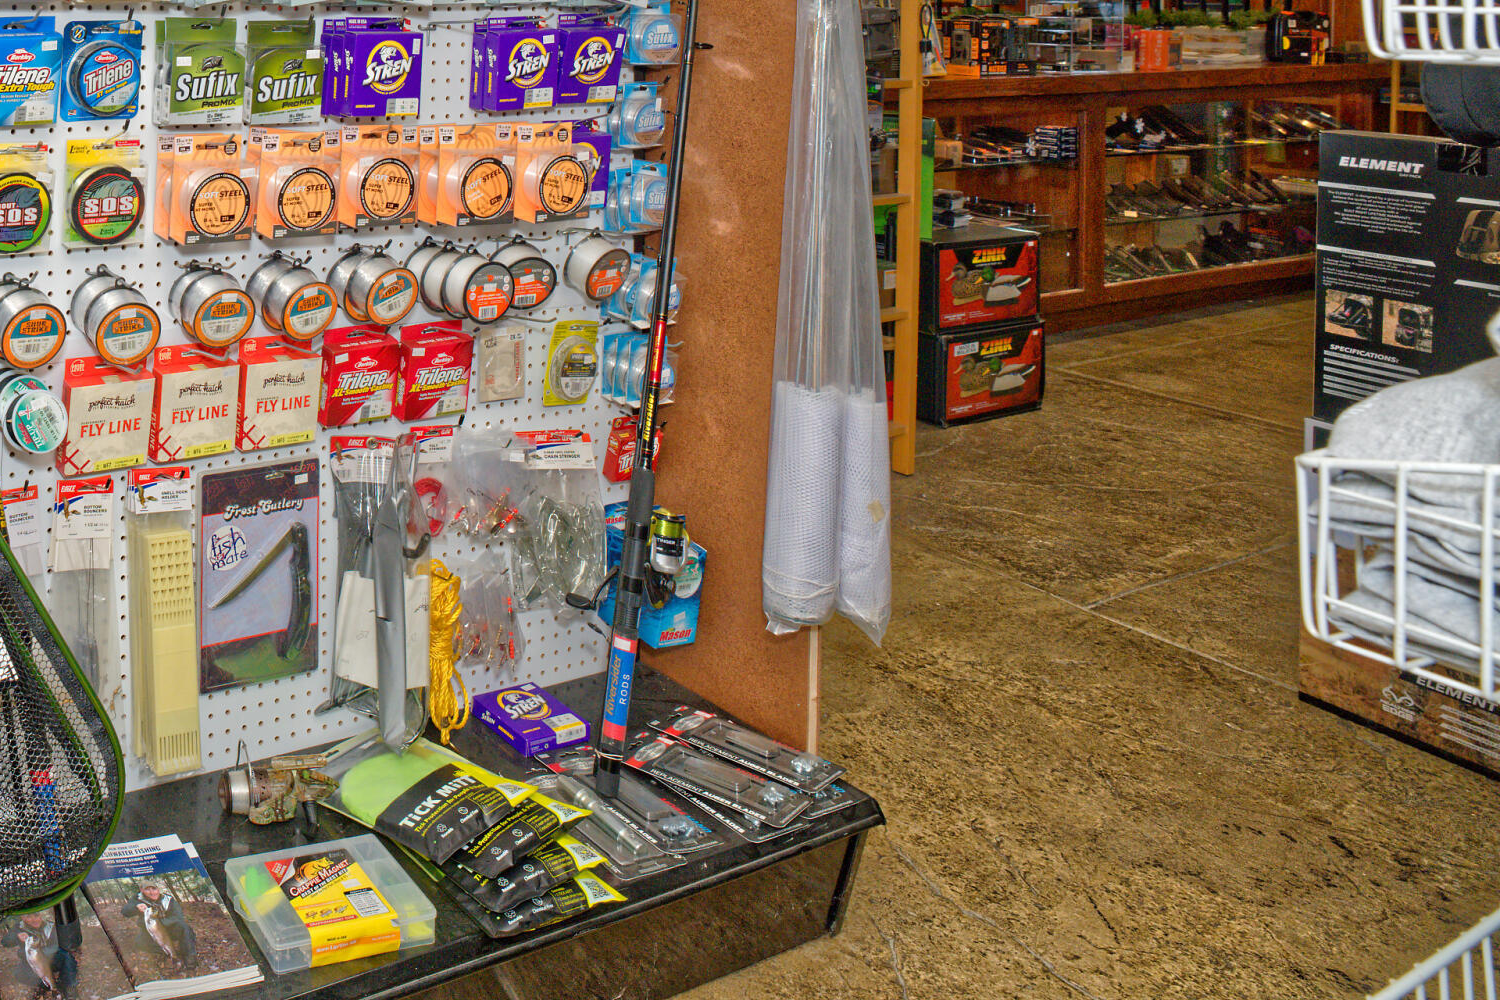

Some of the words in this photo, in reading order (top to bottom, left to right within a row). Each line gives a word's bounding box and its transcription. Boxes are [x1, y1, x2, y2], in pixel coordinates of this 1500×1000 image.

[362, 55, 413, 87] STREN
[505, 55, 549, 82] STREN
[571, 49, 615, 77] STREN
[0, 83, 25, 93] Extra
[26, 82, 55, 94] Tough
[85, 60, 133, 97] Trilene
[174, 70, 240, 102] Sufix
[256, 69, 318, 102] Sufix
[1338, 155, 1425, 175] ELEMENT
[648, 189, 669, 205] Sufi
[972, 247, 1007, 264] ZINK
[980, 338, 1013, 355] ZINK
[340, 370, 390, 390] Trilene
[418, 366, 463, 385] Trilene
[179, 384, 204, 398] perfect
[88, 397, 114, 412] perfect
[171, 408, 197, 425] FLY
[197, 403, 229, 421] LINE
[256, 398, 281, 415] FLY
[281, 394, 312, 411] LINE
[80, 421, 106, 439] FLY
[108, 417, 143, 434] LINE
[222, 502, 258, 520] Frost
[258, 497, 304, 516] Cutlery
[210, 526, 248, 561] fish
[211, 548, 250, 571] mate
[659, 628, 692, 643] Mason
[605, 654, 624, 719] Riversider
[619, 673, 631, 706] RODS
[1415, 676, 1498, 713] ELEMENT
[503, 694, 548, 721] STREN
